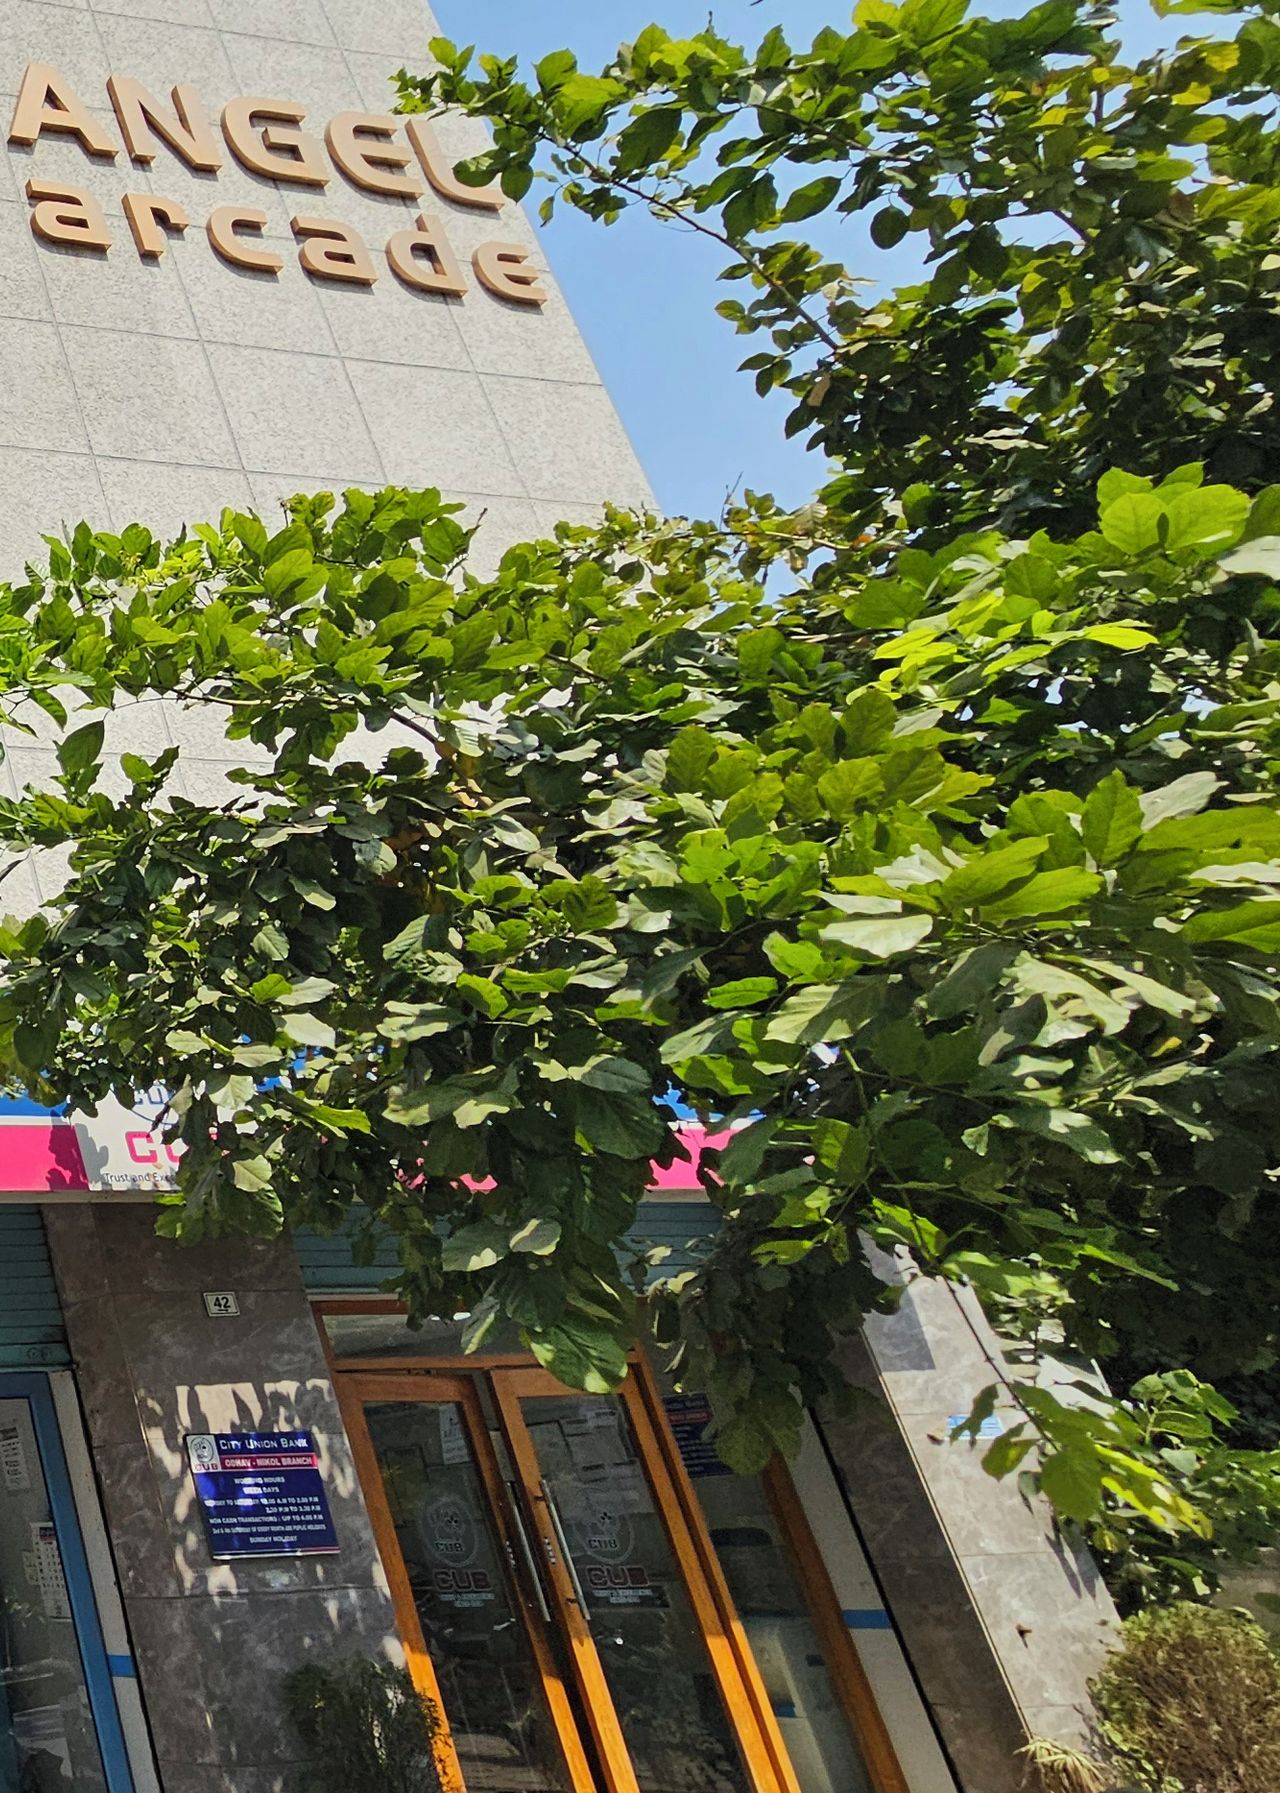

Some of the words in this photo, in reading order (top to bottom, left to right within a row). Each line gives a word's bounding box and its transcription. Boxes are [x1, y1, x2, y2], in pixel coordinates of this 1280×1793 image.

[6, 62, 506, 212] ANGEL
[25, 179, 547, 306] arcade
[213, 1296, 232, 1310] 42
[219, 1439, 242, 1450] CITY
[245, 1438, 278, 1450] UNION
[281, 1437, 308, 1448] BANK
[433, 1569, 490, 1591] CUB
[586, 1565, 649, 1587] CUB
